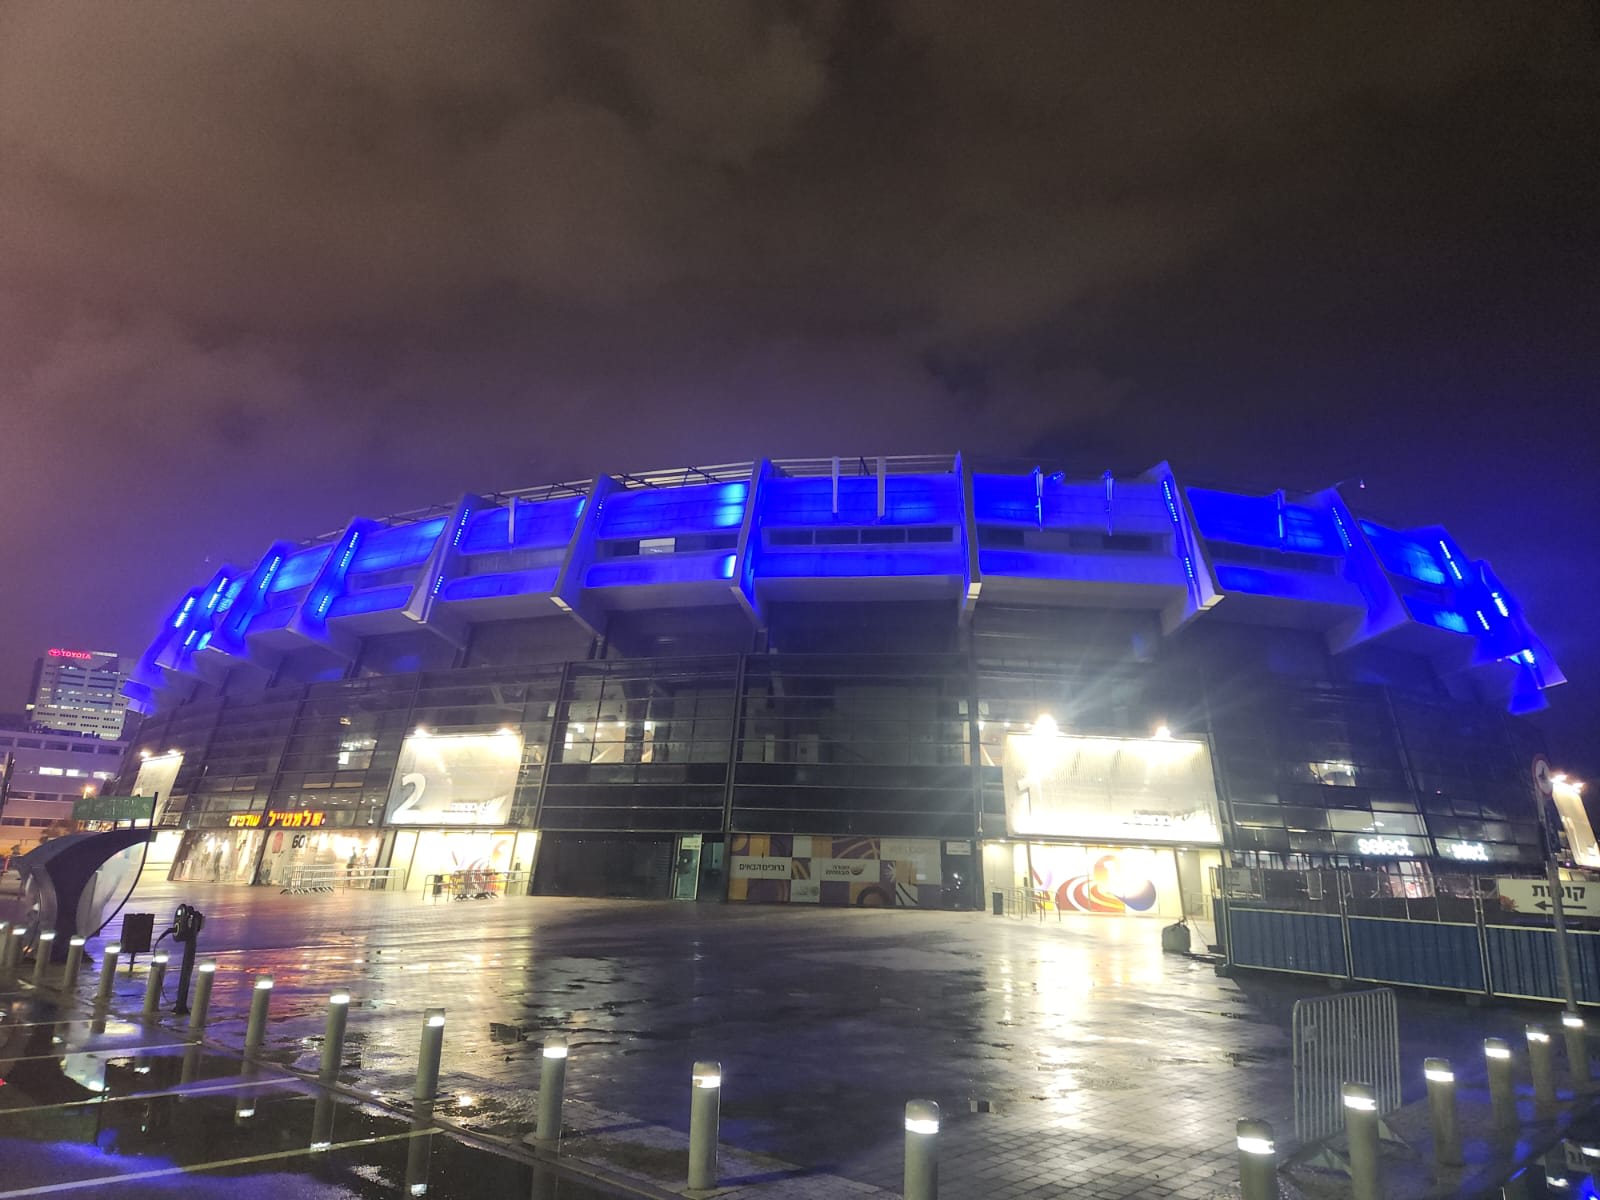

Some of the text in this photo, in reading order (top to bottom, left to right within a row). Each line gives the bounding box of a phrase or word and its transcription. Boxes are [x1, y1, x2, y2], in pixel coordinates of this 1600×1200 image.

[61, 651, 91, 659] TOYOTA
[391, 773, 425, 824] 2
[229, 814, 261, 827] עודפים
